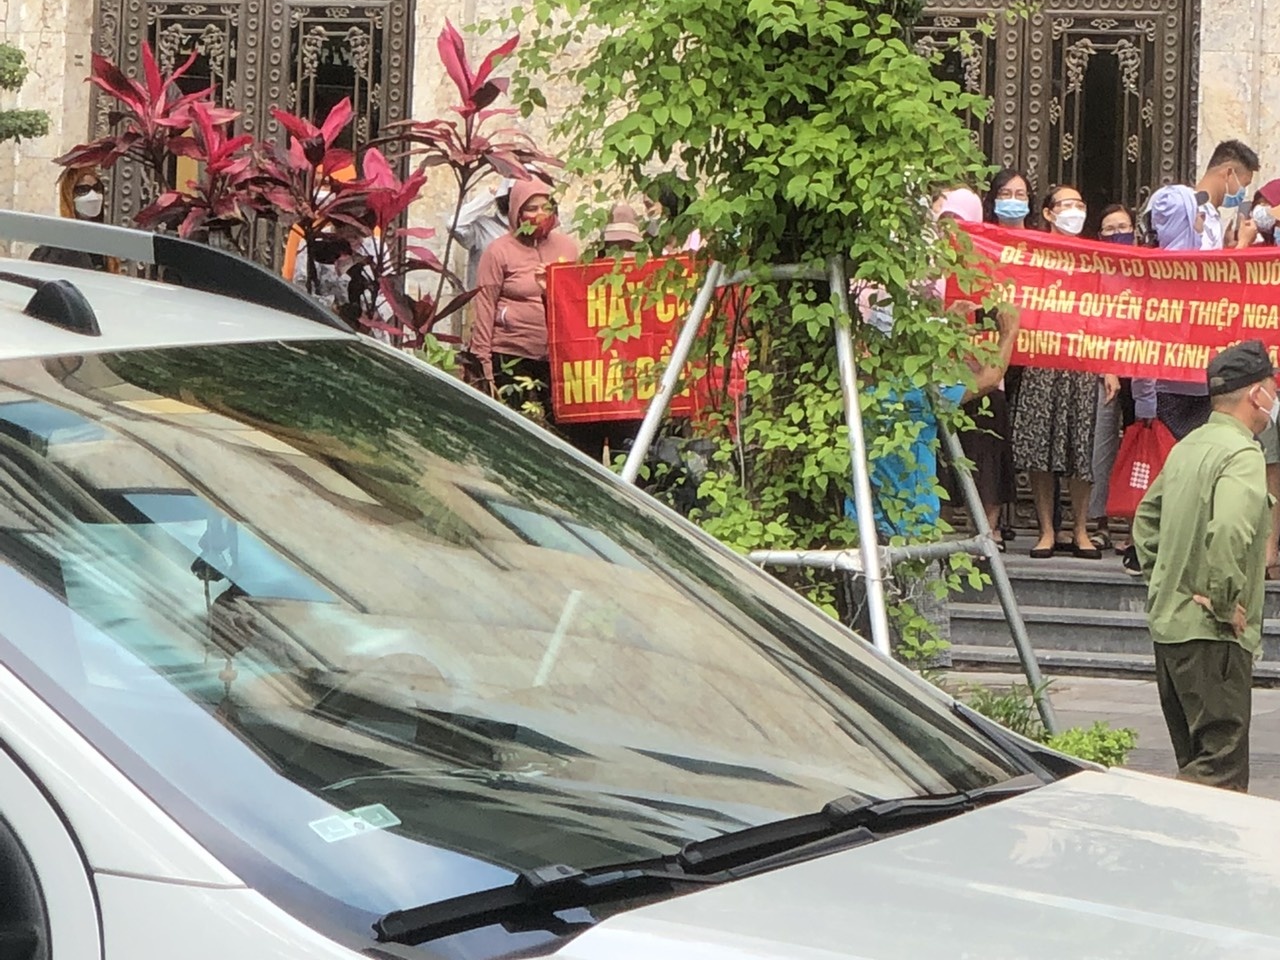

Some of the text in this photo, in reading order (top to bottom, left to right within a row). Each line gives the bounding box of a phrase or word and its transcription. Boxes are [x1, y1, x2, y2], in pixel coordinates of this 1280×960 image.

[1029, 248, 1075, 276] NGHỊ
[1079, 251, 1117, 275] CÁC
[1147, 259, 1198, 282] QUAN
[1201, 257, 1242, 284] NHÀ
[1020, 279, 1076, 314] THẨM
[1078, 288, 1143, 321] QUYỀN
[1145, 297, 1185, 324] CAN
[1188, 297, 1240, 331] THIỆP
[1016, 328, 1062, 359] ĐỊNH
[1063, 329, 1111, 361] TÌNH
[1113, 335, 1159, 367] HÌNH
[1163, 341, 1211, 370] KINH
[562, 350, 625, 405] NHÀ
